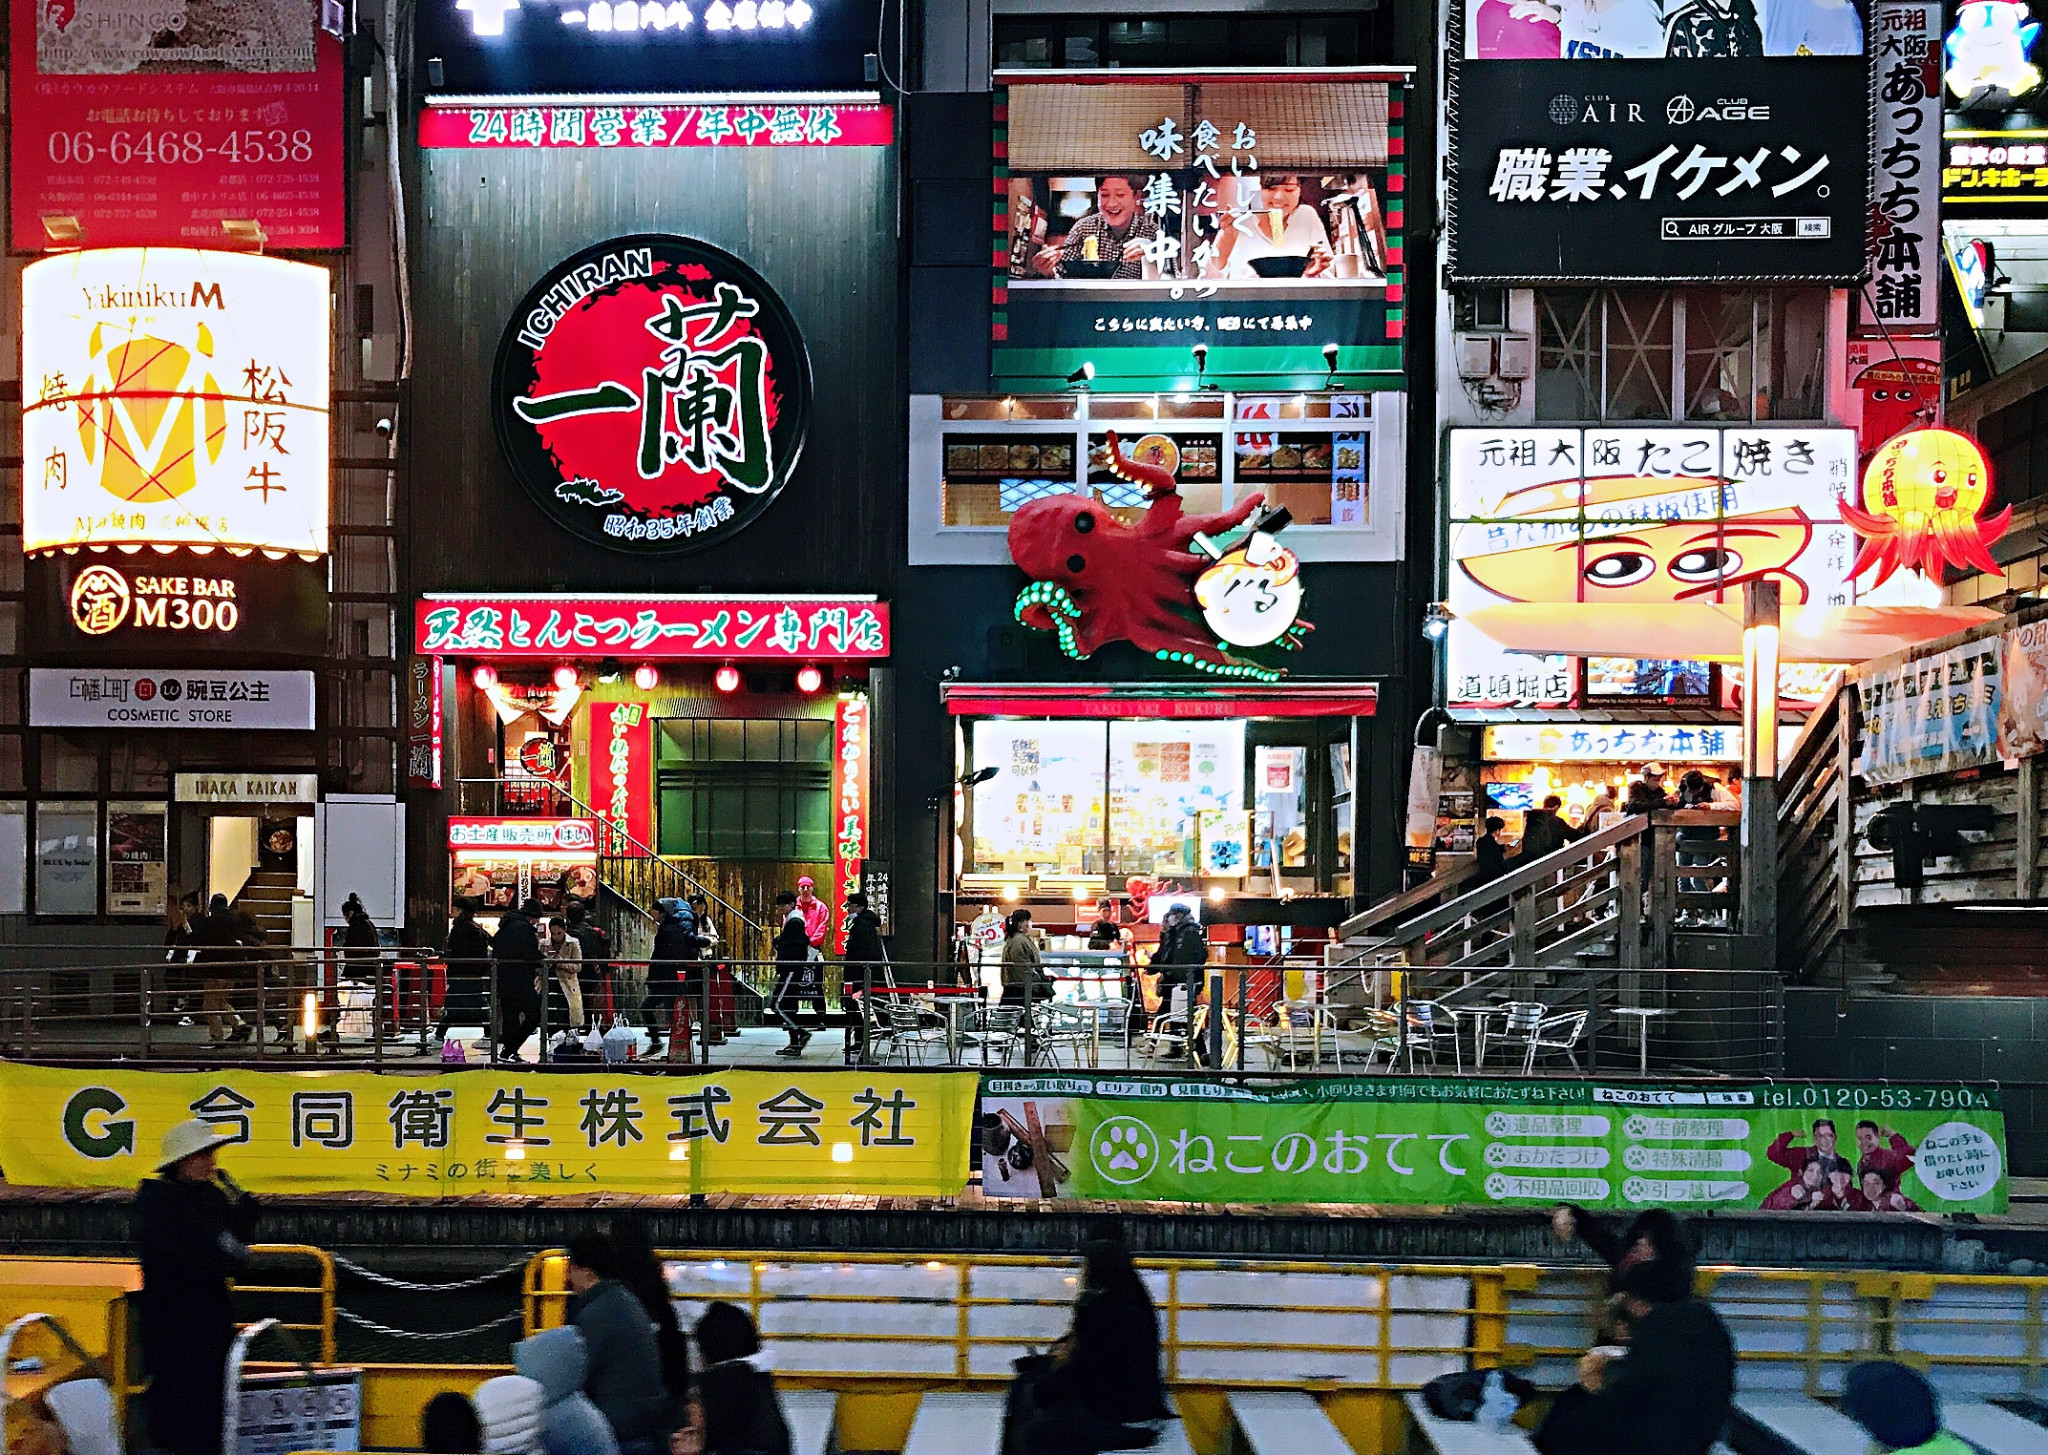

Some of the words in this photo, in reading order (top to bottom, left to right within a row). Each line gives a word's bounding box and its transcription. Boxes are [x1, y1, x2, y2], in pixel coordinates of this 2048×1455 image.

[1881, 7, 1927, 32] 元祖
[1880, 34, 1927, 58] 大阪
[1582, 101, 1645, 123] AIR
[1696, 105, 1770, 121] AGE
[1717, 97, 1748, 106] CLUB
[468, 107, 842, 147] 24時間営業/年中無休
[47, 129, 313, 164] 06-6468-4538
[1231, 120, 1259, 238] おいしく
[1488, 143, 1831, 203] 職業、イケメン。
[1876, 62, 1925, 320] あっちち本舗
[1190, 118, 1221, 299] 食べたいから
[1689, 223, 1710, 235] AIR
[1713, 223, 1756, 235] グループ
[1760, 223, 1783, 236] 大阪
[82, 283, 186, 310] Yakiniku
[190, 281, 224, 310] M
[517, 247, 653, 351] ICHIRAN
[513, 282, 774, 494] 一蘭
[241, 358, 292, 504] 松阪牛
[1478, 437, 1815, 478] 元祖大阪たこ焼き
[603, 496, 735, 540] 昭和35年創業
[135, 576, 188, 597] SAKE
[192, 577, 236, 598] BAR
[134, 598, 239, 632] M300
[423, 605, 886, 654] 天然とんこつラーメン専門店
[1457, 675, 1569, 700] 道頓堀店
[107, 708, 180, 722] COSMETIC
[188, 709, 232, 723] STORE
[408, 662, 433, 780] ラーメン一蘭
[1569, 728, 1726, 756] あっちち本舗
[195, 780, 238, 796] INAKA
[246, 780, 298, 796] KAIKAN
[450, 825, 552, 844] お土産販売所
[1101, 1083, 1134, 1093] エリア
[1602, 1090, 1676, 1103] ねこのおてて
[189, 1084, 916, 1149] 合同衛生株式会社
[1513, 1116, 1583, 1134] 遺品整理
[1654, 1120, 1724, 1138] 生前整理
[1168, 1127, 1470, 1177] ねこのおてて
[1925, 1133, 1982, 1150] ねこの手も
[1513, 1148, 1600, 1165] おかたづけ
[1652, 1151, 1724, 1168] 特殊清掃
[375, 1158, 598, 1183] ミナミの街を美しく
[1936, 1163, 1985, 1180] お申し付け
[1512, 1178, 1600, 1198] 不用品回収
[1652, 1182, 1724, 1200] 引っ越し
[1948, 1180, 1980, 1192] 下さい
